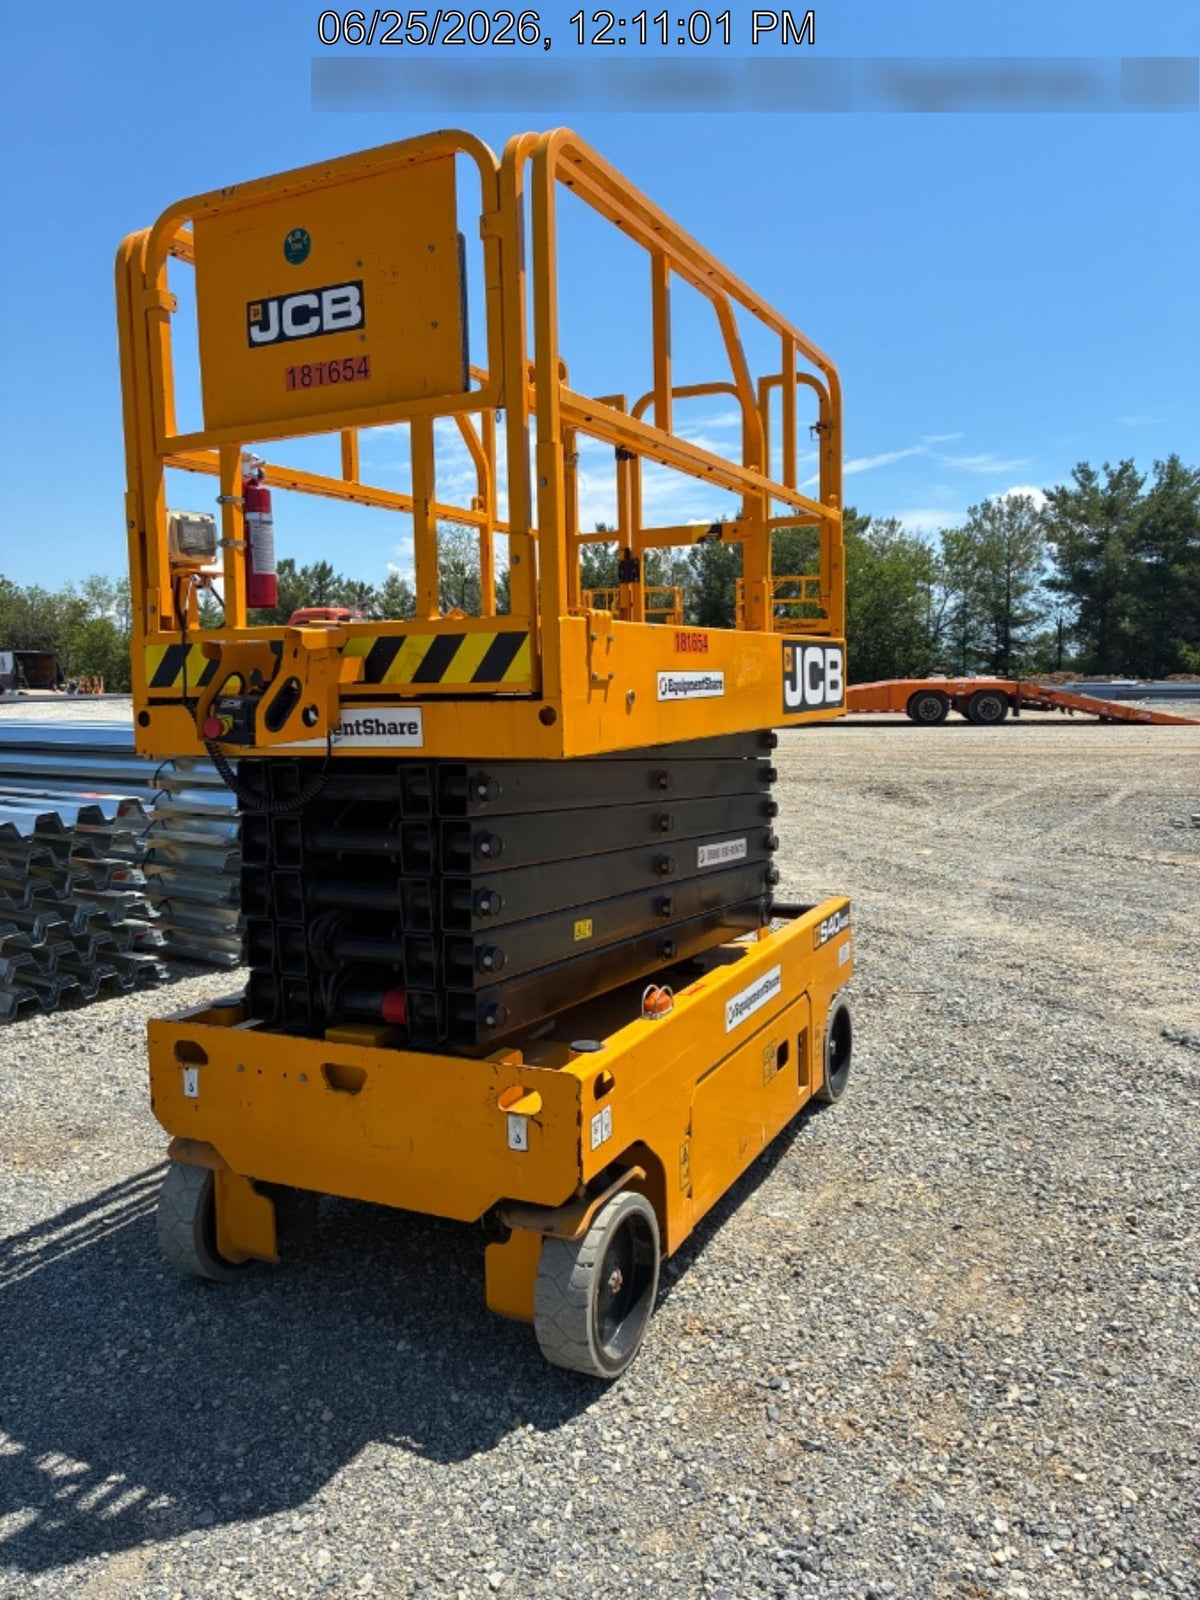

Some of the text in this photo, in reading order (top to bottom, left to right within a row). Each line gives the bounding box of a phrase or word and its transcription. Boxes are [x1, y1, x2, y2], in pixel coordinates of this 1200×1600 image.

[249, 284, 362, 343] JCB
[287, 355, 370, 390] 181654
[674, 632, 709, 654] 181654
[667, 675, 723, 695] EquipmentShare
[784, 646, 843, 707] JCB
